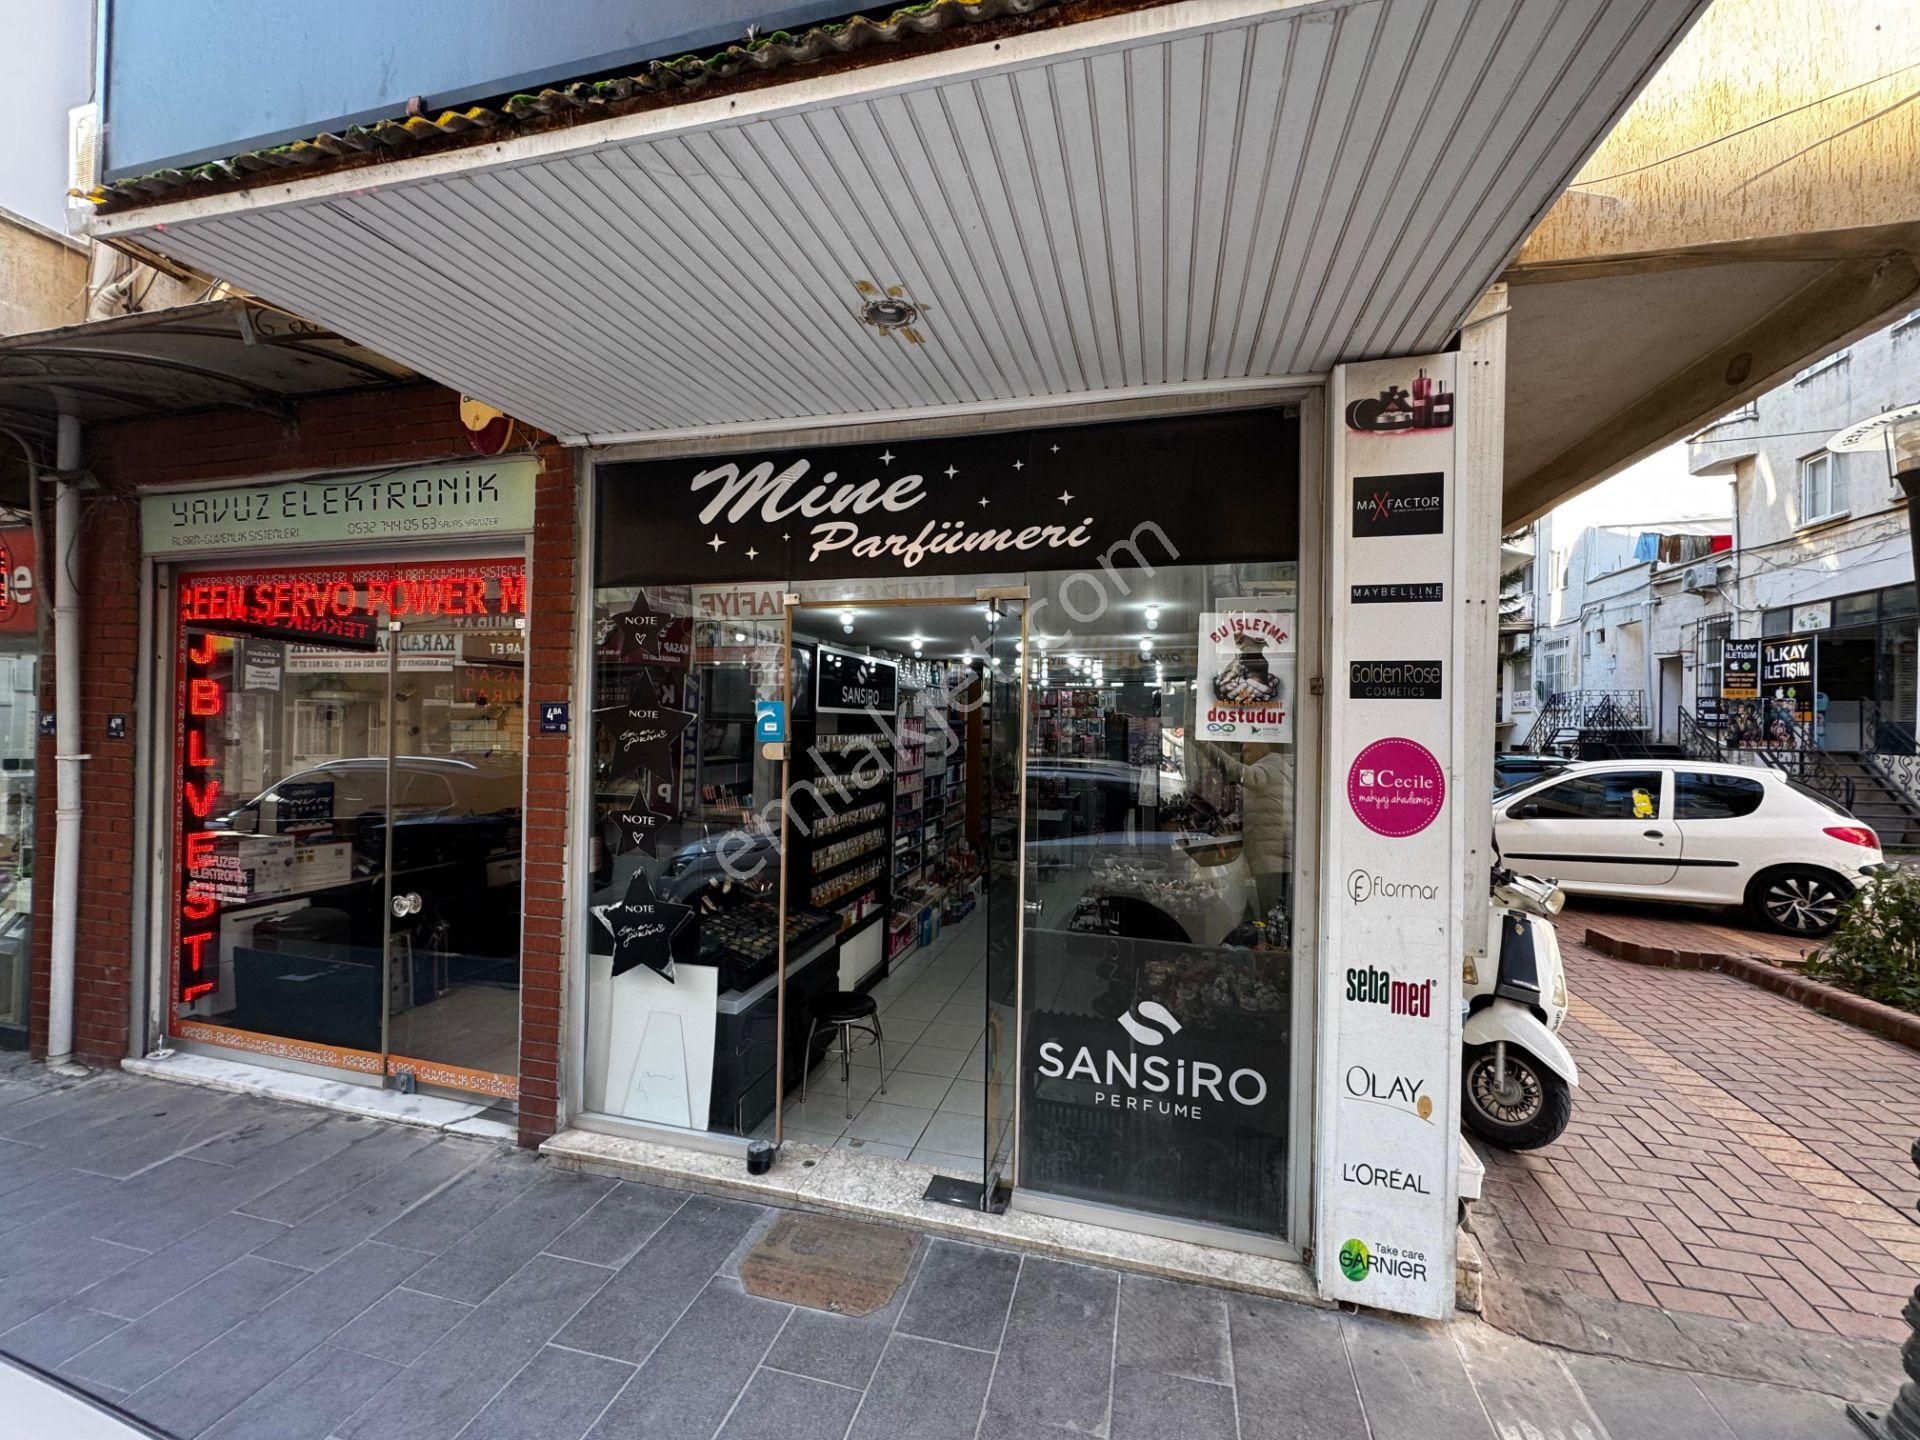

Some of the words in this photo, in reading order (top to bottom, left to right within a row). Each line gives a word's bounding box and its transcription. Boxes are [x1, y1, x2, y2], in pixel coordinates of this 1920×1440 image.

[172, 493, 269, 527] YAVUZ
[282, 470, 498, 518] ELEKTRONİK
[690, 458, 927, 524] Mine
[347, 521, 377, 535] 0532
[403, 518, 419, 531] 05
[422, 517, 437, 530] 63
[809, 516, 1094, 567] Parfümeri
[256, 581, 356, 617] SERVO
[366, 576, 488, 615] POWER
[1353, 585, 1442, 597] MAYBELLINE
[625, 616, 657, 626] NOTE
[1209, 625, 1229, 644] BU
[1351, 663, 1401, 684] Golden
[1403, 663, 1440, 684] Rose
[1365, 686, 1425, 697] COSMETICS
[629, 709, 659, 719] NOTE
[1207, 707, 1286, 724] dostudur
[1376, 769, 1434, 790] Cecile
[1358, 789, 1390, 809] makyaj
[1390, 790, 1434, 808] akademisi
[622, 814, 656, 826] NOTE
[1373, 875, 1439, 900] flormar
[625, 904, 655, 914] NOTE
[1346, 1065, 1424, 1103] OLAY
[1095, 1092, 1202, 1120] PERFUME
[1343, 1163, 1430, 1195] L'ORÉAL
[1375, 1242, 1399, 1256] Take
[1401, 1247, 1427, 1262] care.
